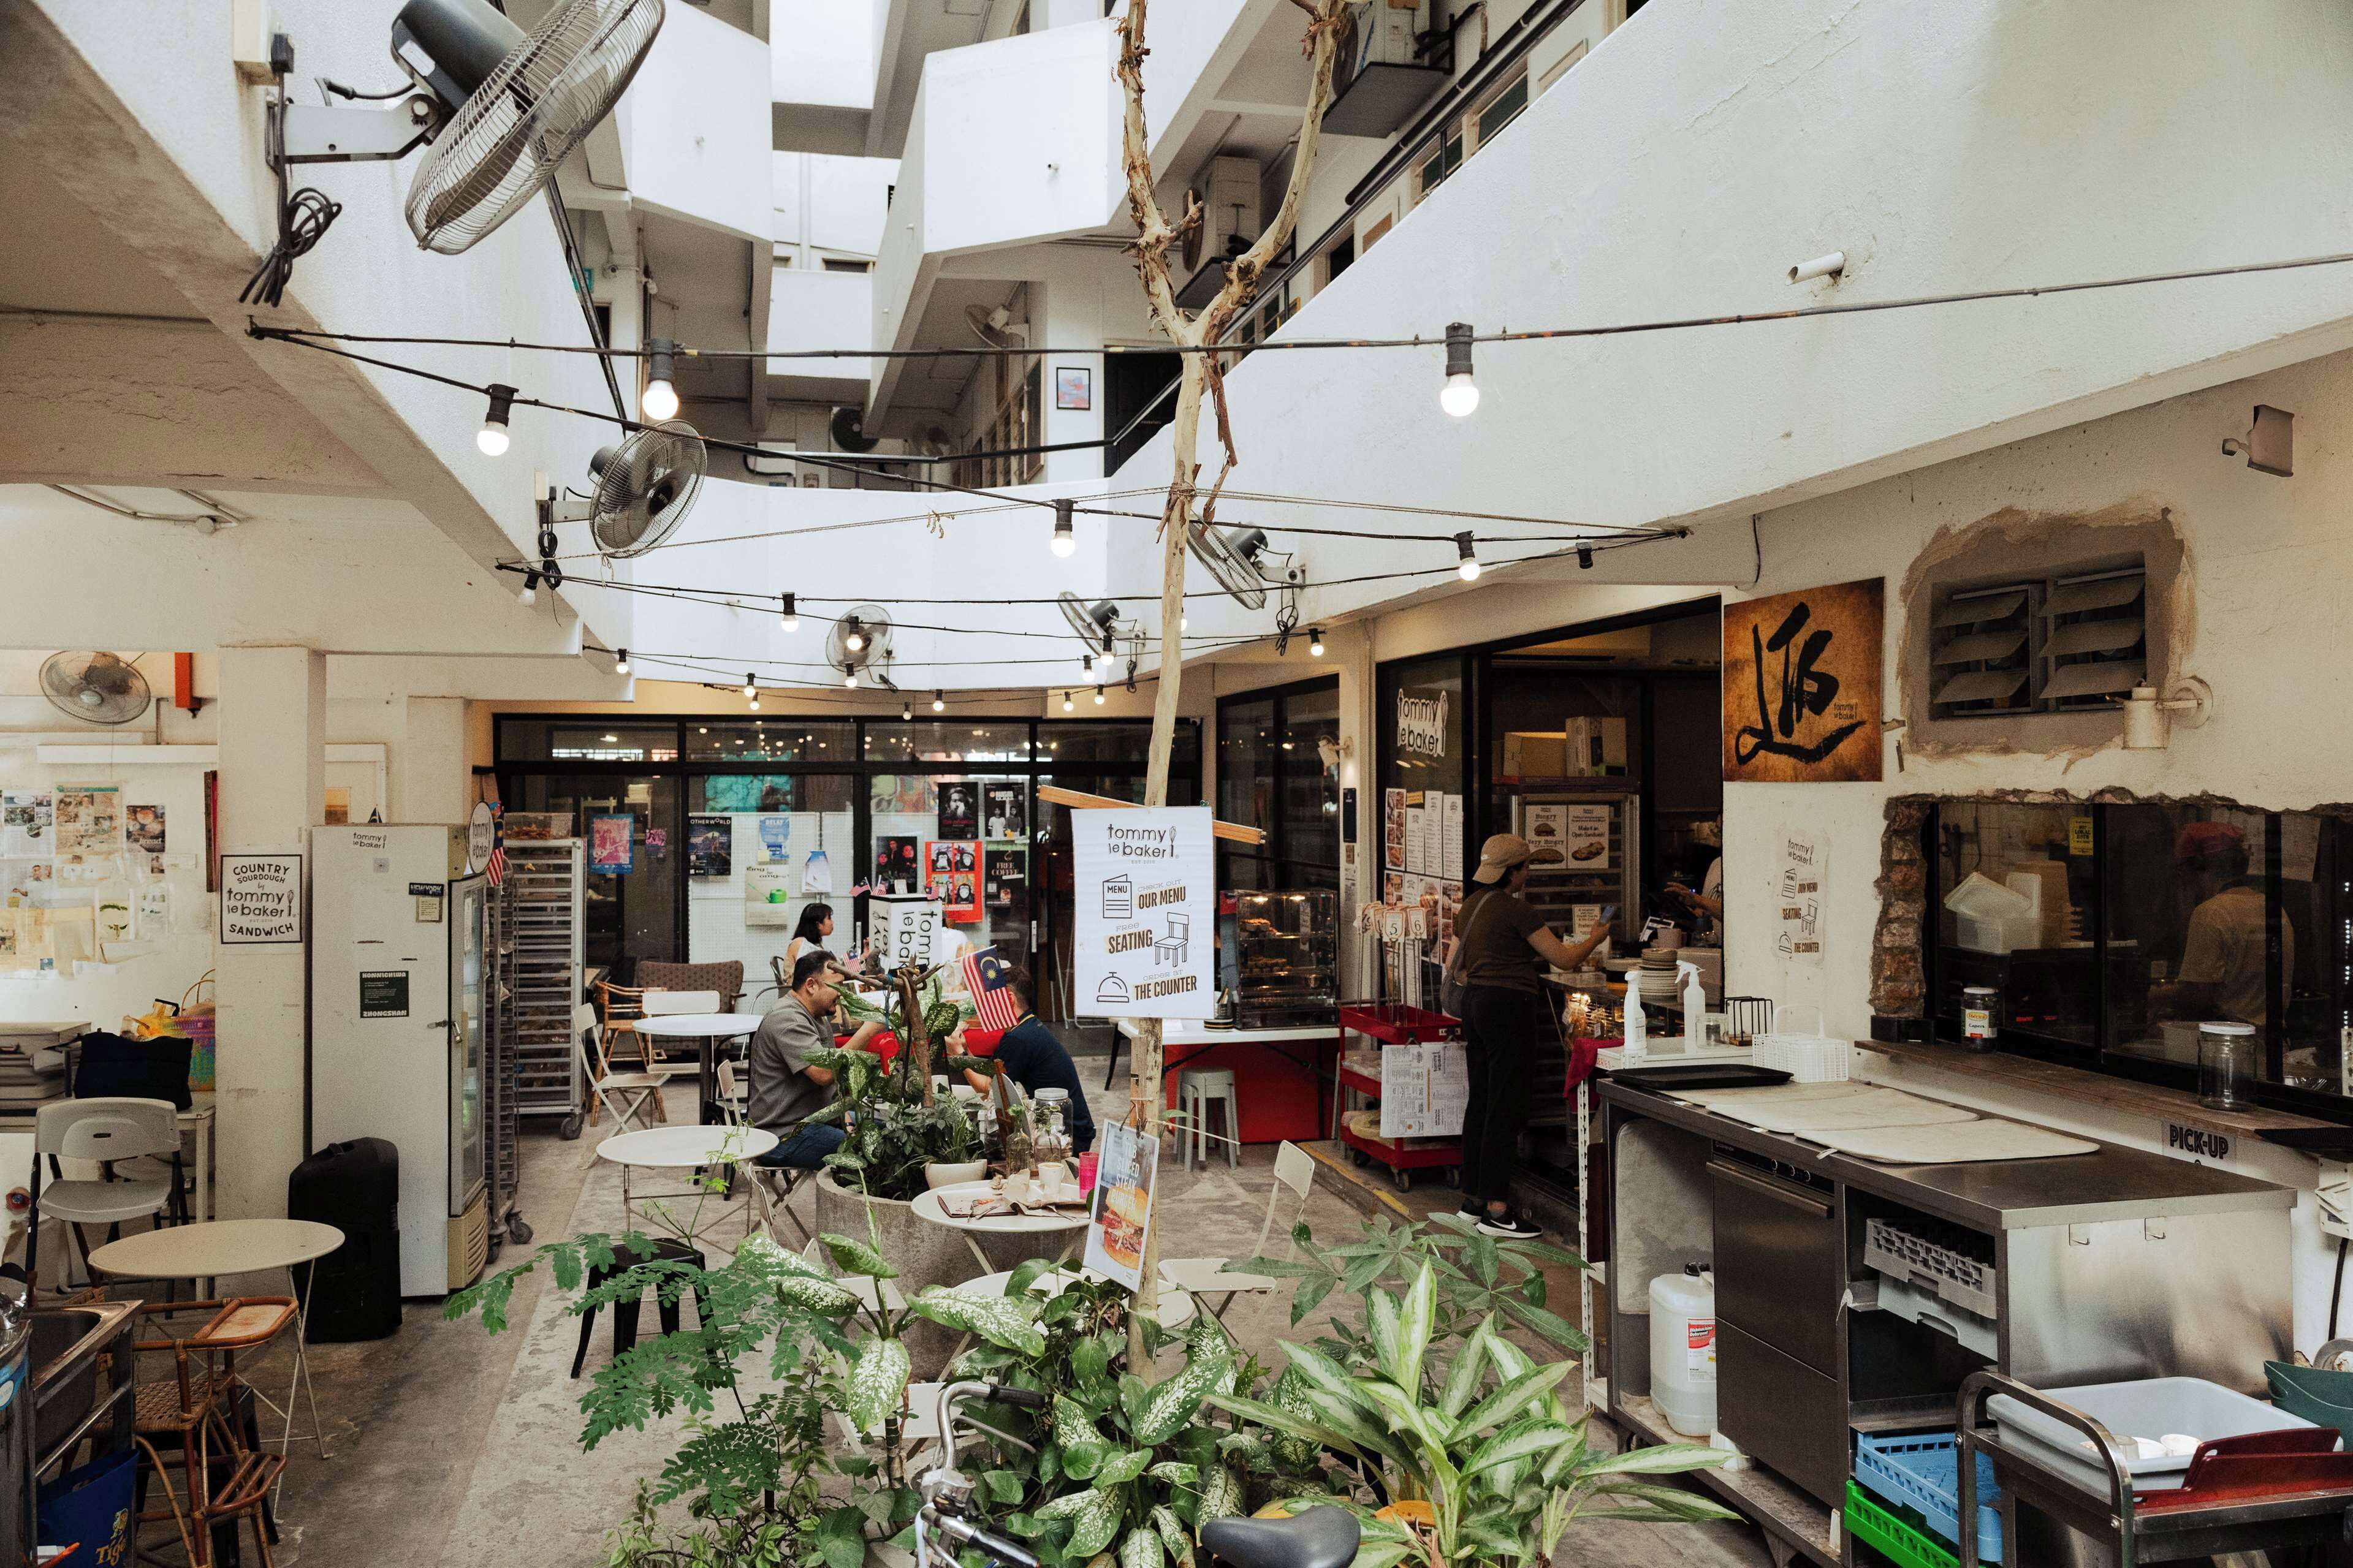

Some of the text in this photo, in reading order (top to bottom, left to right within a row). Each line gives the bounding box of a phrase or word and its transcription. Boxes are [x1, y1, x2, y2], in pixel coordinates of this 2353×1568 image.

[1399, 691, 1439, 727] tommy
[1834, 702, 1853, 711] tommy
[1839, 711, 1854, 720] baker
[1397, 723, 1439, 754] le baker
[353, 832, 382, 843] tommy
[1108, 824, 1166, 843] tommy
[360, 839, 381, 849] baker
[1109, 842, 1166, 858] le baker
[1788, 838, 1809, 855] tommy
[1793, 850, 1809, 865] baker
[233, 863, 290, 876] COUNTRY
[237, 874, 286, 884] SOURDOUGH
[257, 881, 265, 891] by
[227, 887, 285, 905] tommy
[1107, 885, 1128, 894] MENU
[1138, 886, 1187, 910] OUR MENU
[227, 903, 284, 918] le baker
[1782, 907, 1802, 920] SEATING
[229, 923, 294, 937] SANDWICH
[1389, 923, 1397, 936] 5
[1414, 920, 1421, 931] 6
[1108, 929, 1154, 955] SEATING
[1802, 942, 1820, 953] COUNTER
[1135, 975, 1197, 1001] THE COUNTER
[2170, 1124, 2229, 1160] PICK-UP
[1117, 1156, 1139, 1178] SLICED
[1116, 1173, 1136, 1196] STEAK
